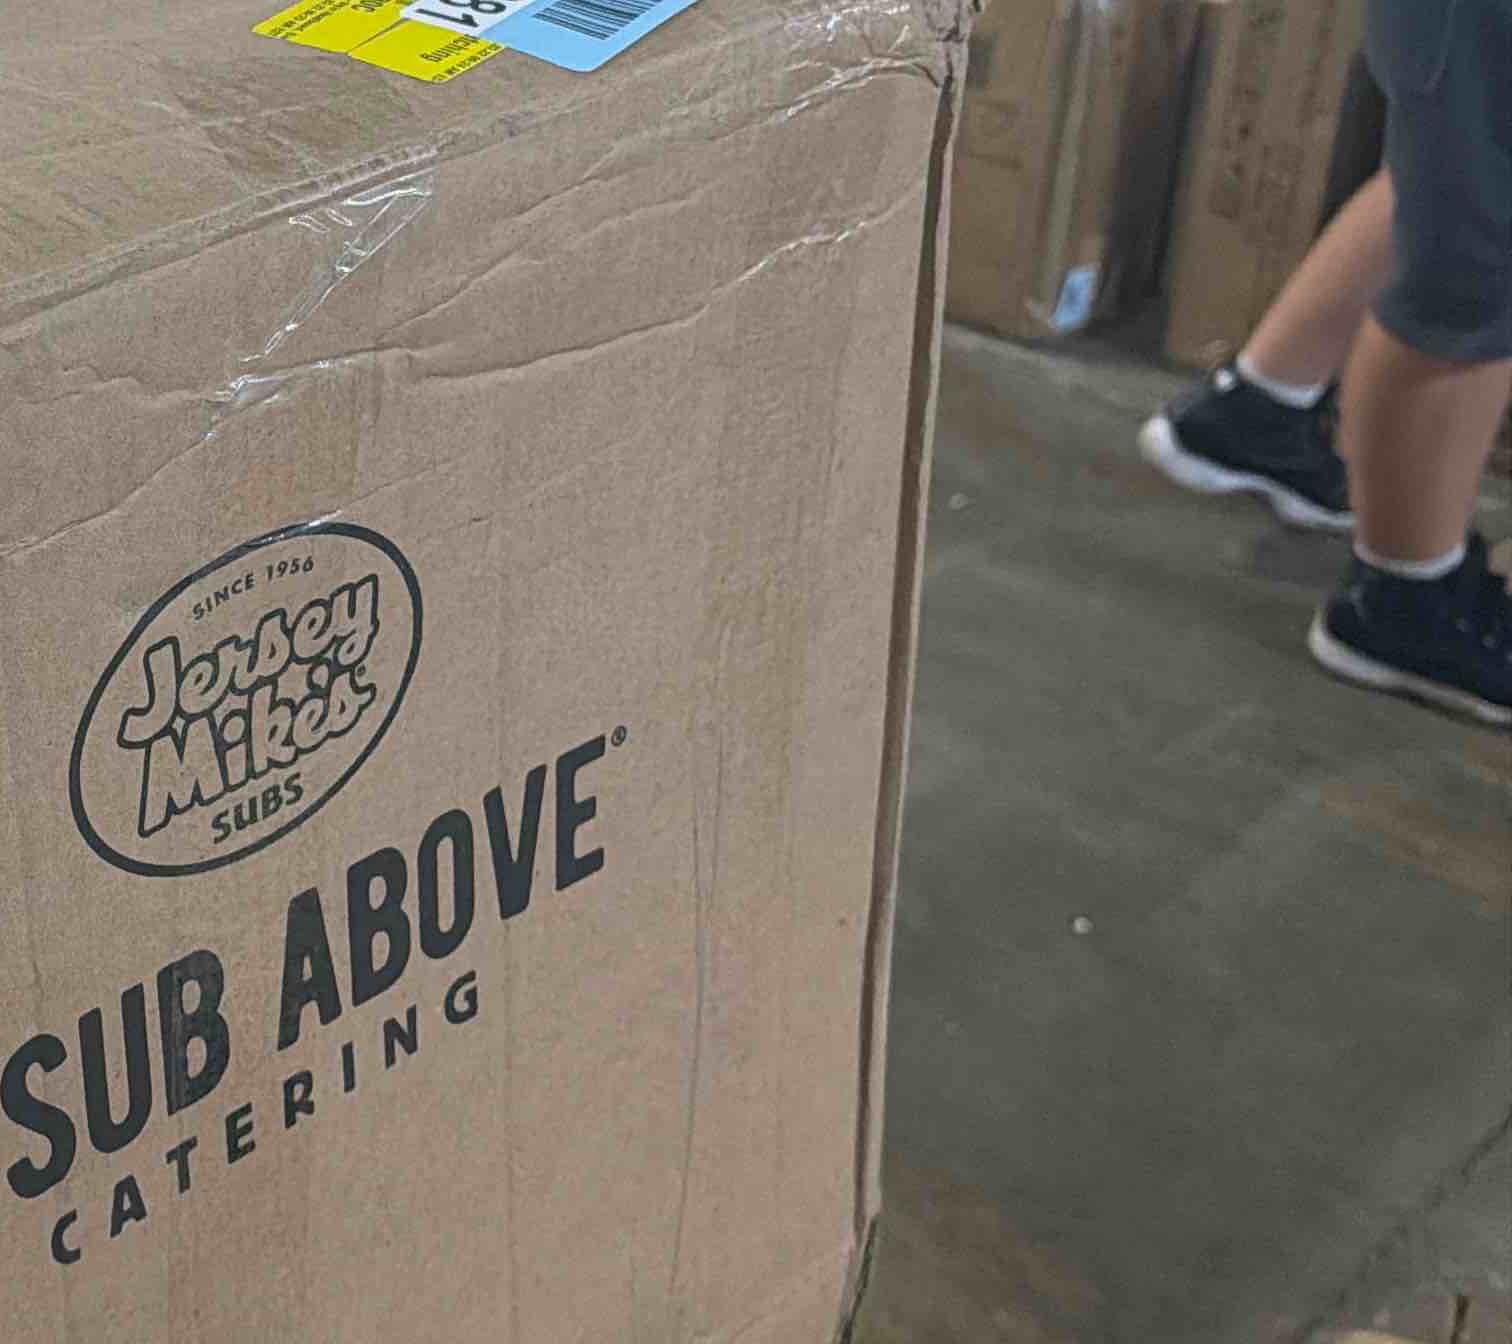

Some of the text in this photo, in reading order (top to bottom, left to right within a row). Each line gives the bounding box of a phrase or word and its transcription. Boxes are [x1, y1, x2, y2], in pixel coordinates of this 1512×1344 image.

[117, 573, 381, 751] Jersey
[190, 554, 315, 622] SINCE 1956
[137, 660, 377, 839] Mike's
[211, 771, 305, 845] SUBS
[275, 732, 610, 1052] ABOVE
[50, 969, 482, 1265] CATERING
